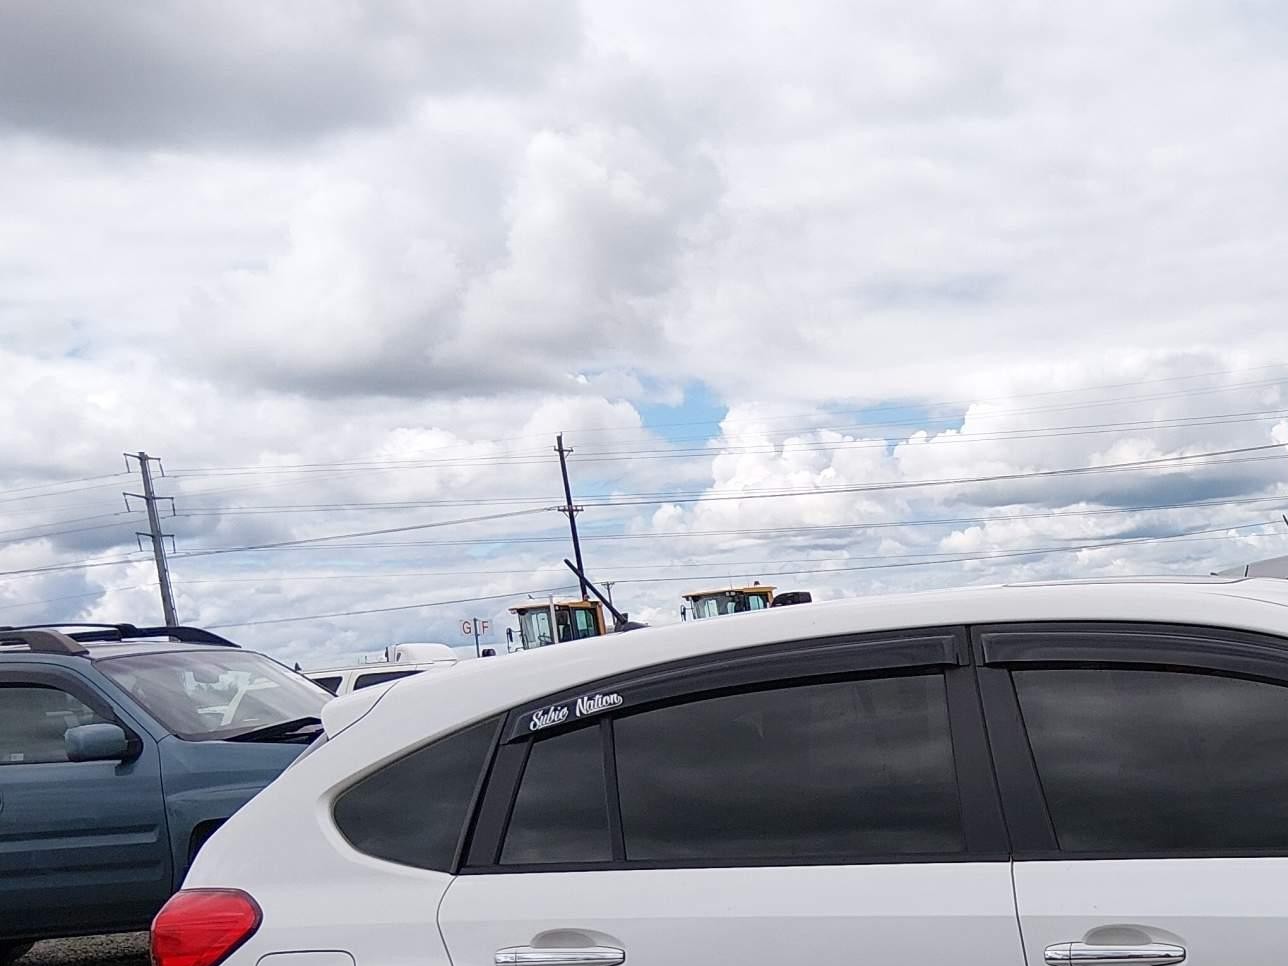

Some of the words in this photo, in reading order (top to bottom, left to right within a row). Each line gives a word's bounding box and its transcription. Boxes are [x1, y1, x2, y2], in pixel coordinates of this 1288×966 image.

[462, 620, 472, 635] G
[481, 620, 489, 635] F
[576, 693, 623, 717] Nation
